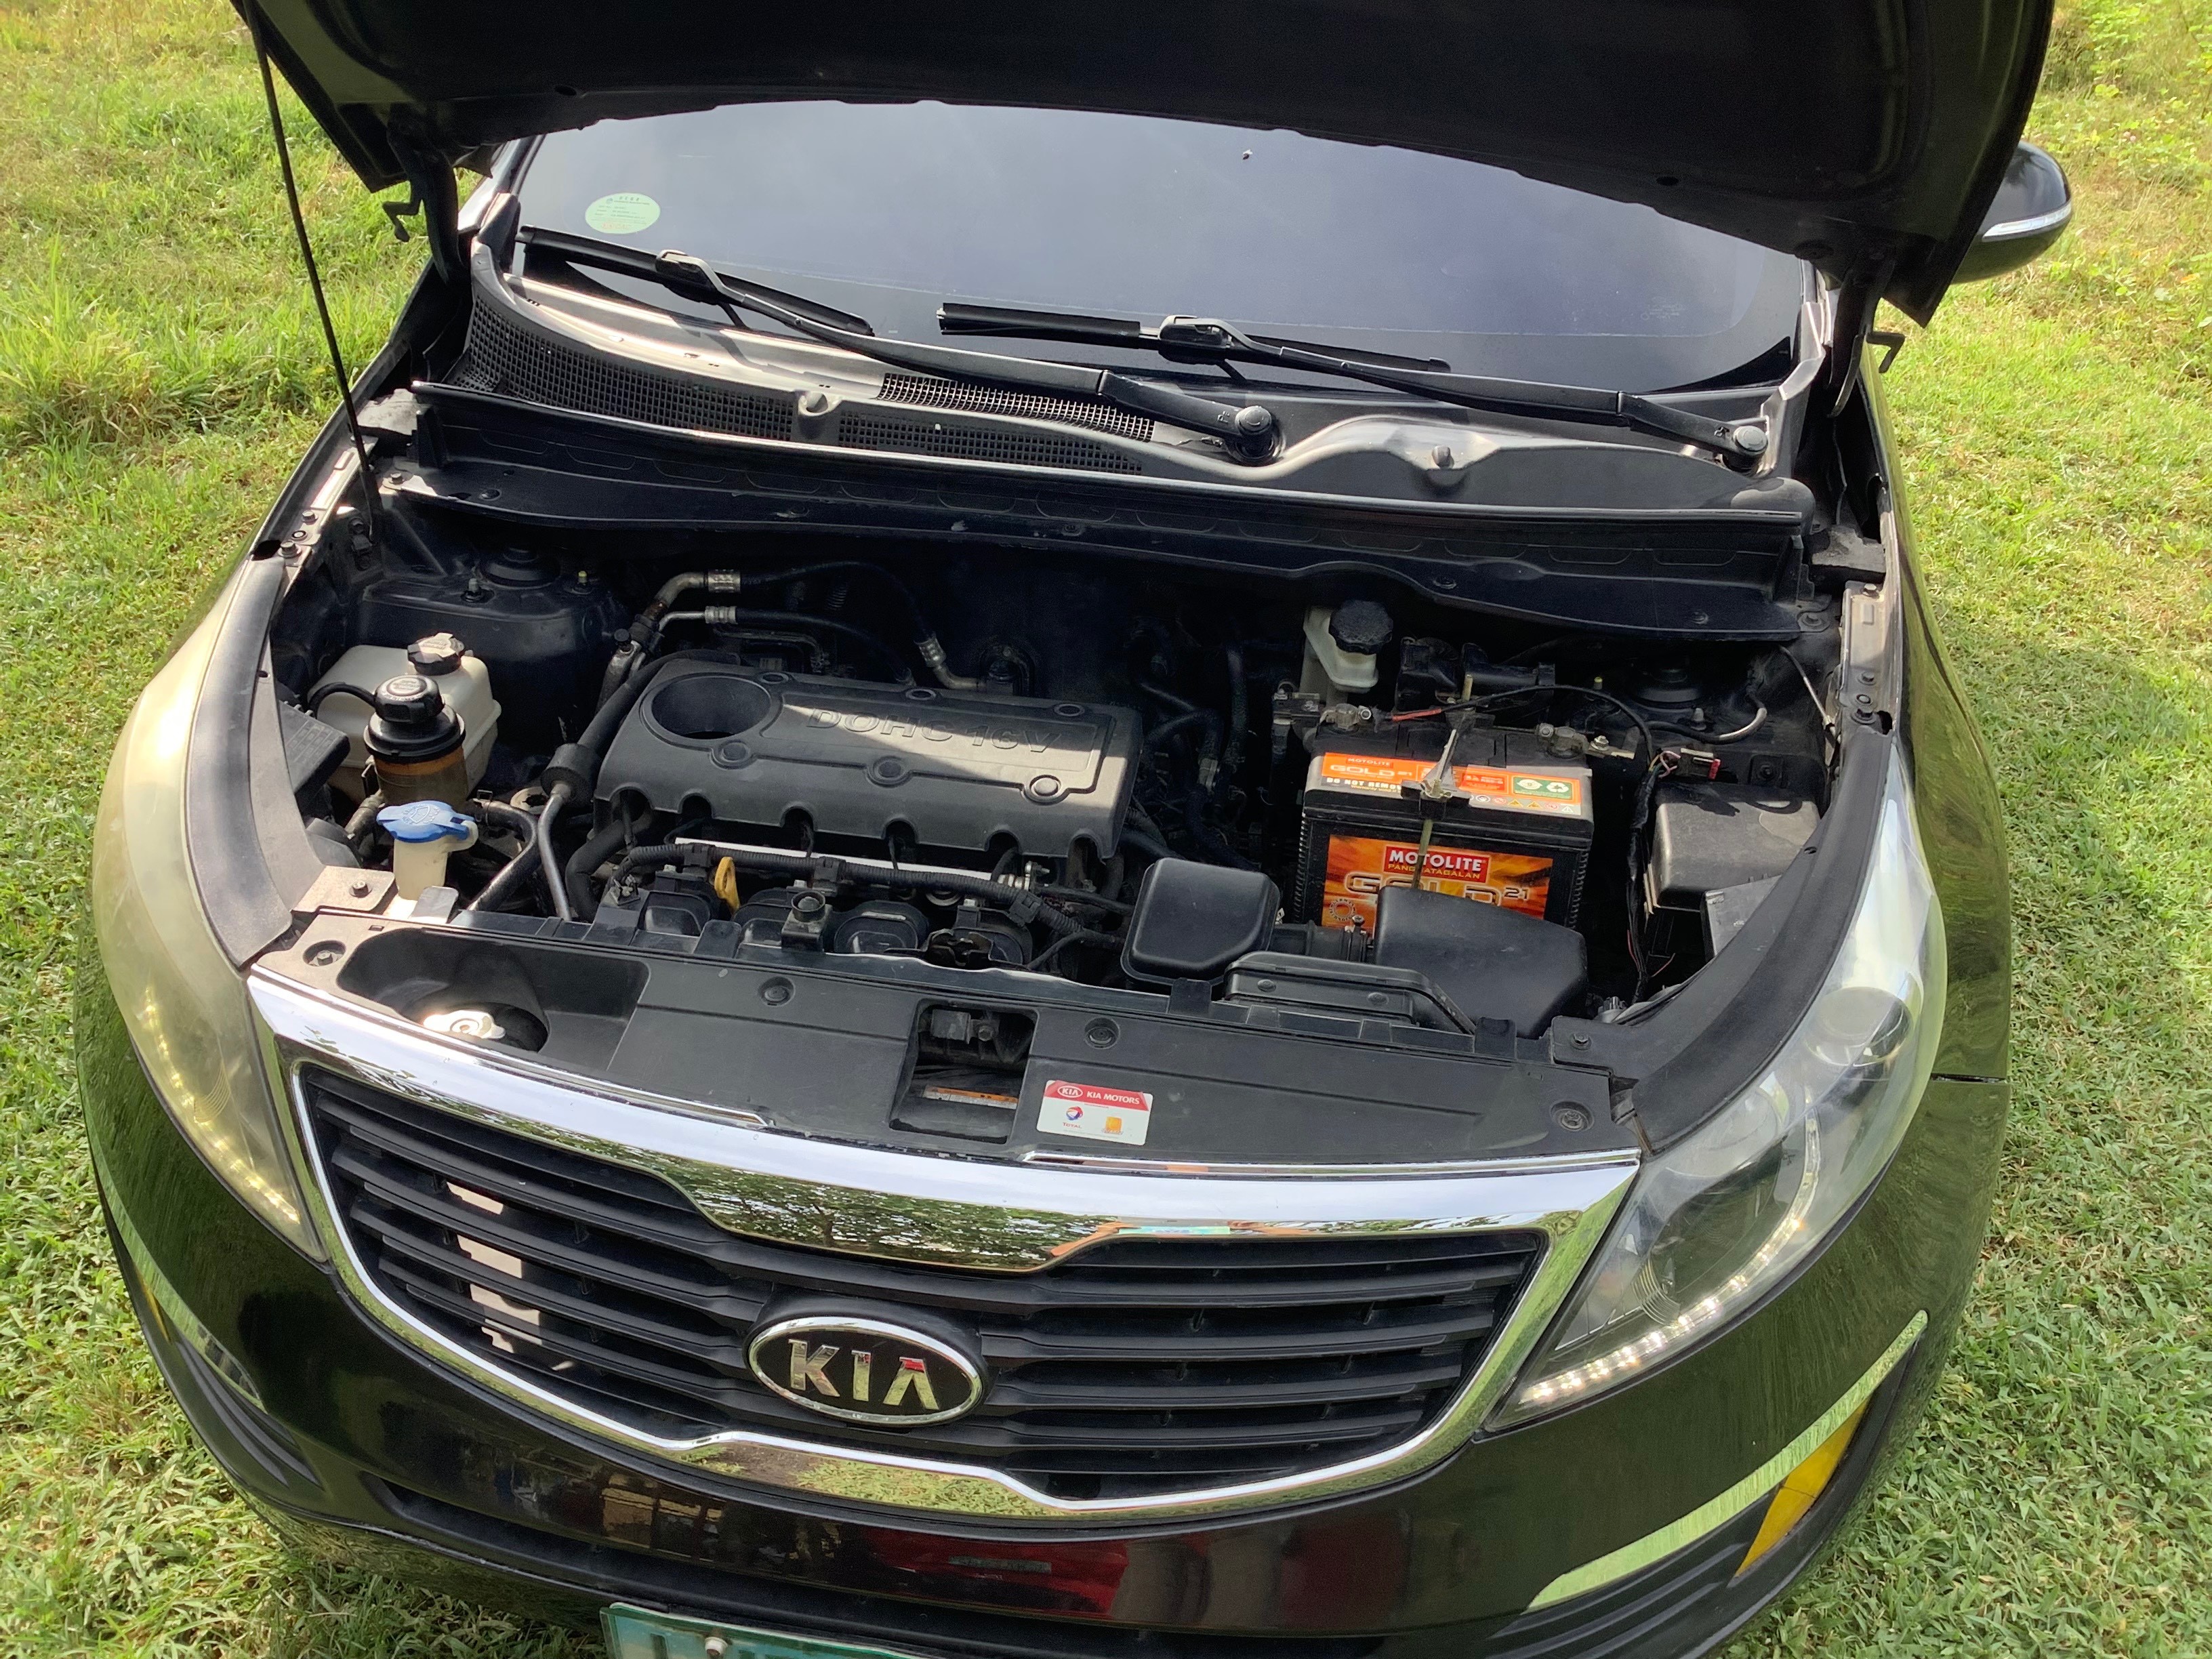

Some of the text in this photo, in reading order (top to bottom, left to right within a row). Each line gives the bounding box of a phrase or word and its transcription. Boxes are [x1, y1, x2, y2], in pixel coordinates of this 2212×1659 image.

[806, 707, 1061, 753] DOHC 16V
[1347, 758, 1391, 766] MOTOLITE
[1330, 764, 1395, 777] GOLD
[1389, 850, 1482, 872] MOTOLITE
[1388, 863, 1481, 879] PANGATAGALAN
[1061, 1087, 1080, 1097] KIA
[1086, 1090, 1141, 1105] KIA MOTORS
[787, 1338, 940, 1410] KIA
